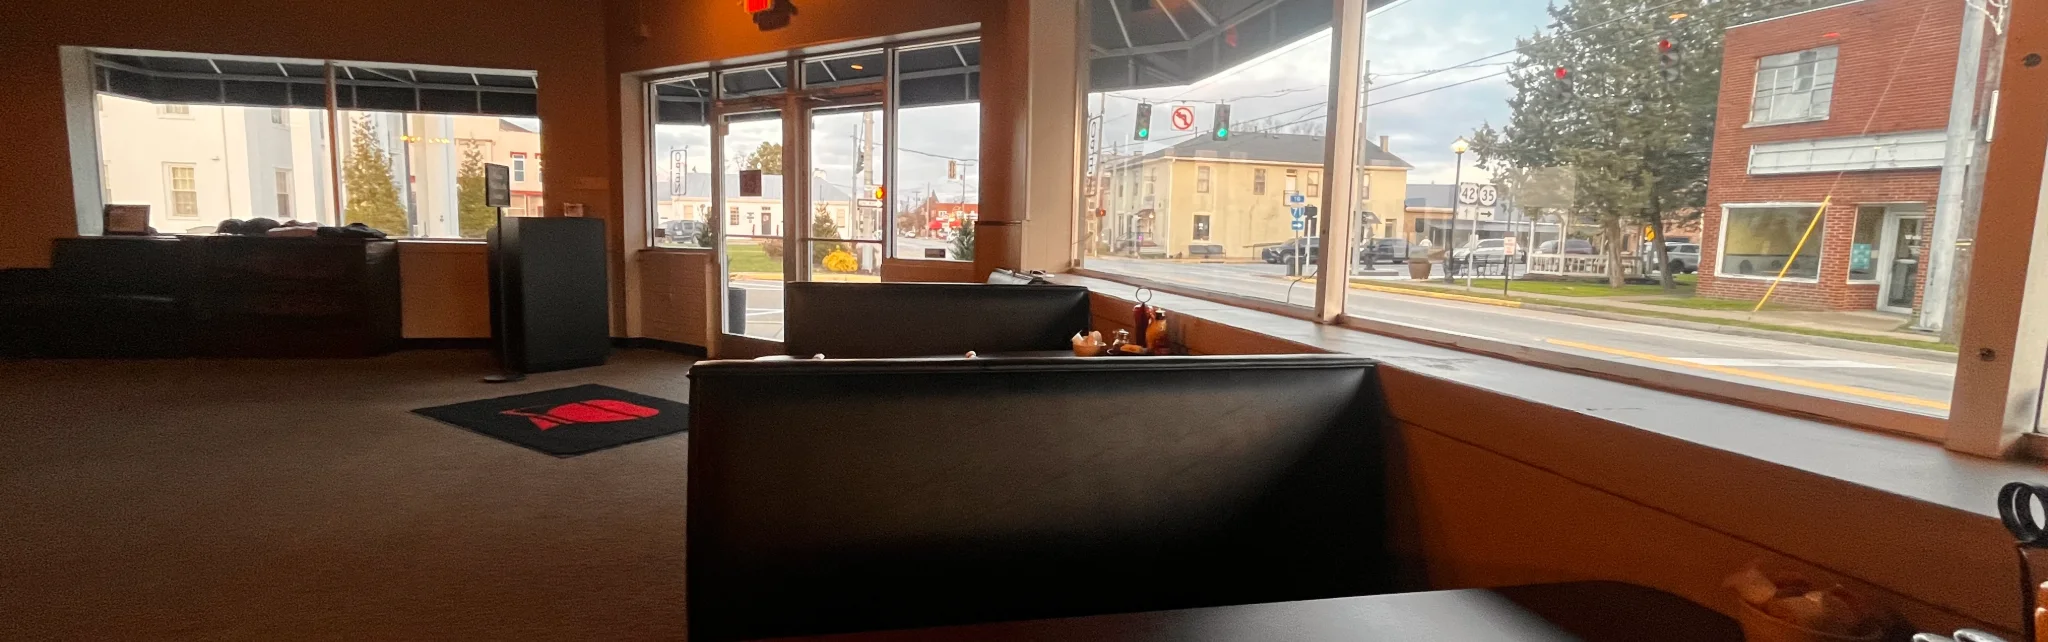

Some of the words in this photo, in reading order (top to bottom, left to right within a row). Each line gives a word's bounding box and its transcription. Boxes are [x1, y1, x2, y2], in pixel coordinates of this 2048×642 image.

[1461, 187, 1476, 200] 42
[1481, 189, 1494, 202] 35
[1292, 207, 1302, 217] 71
